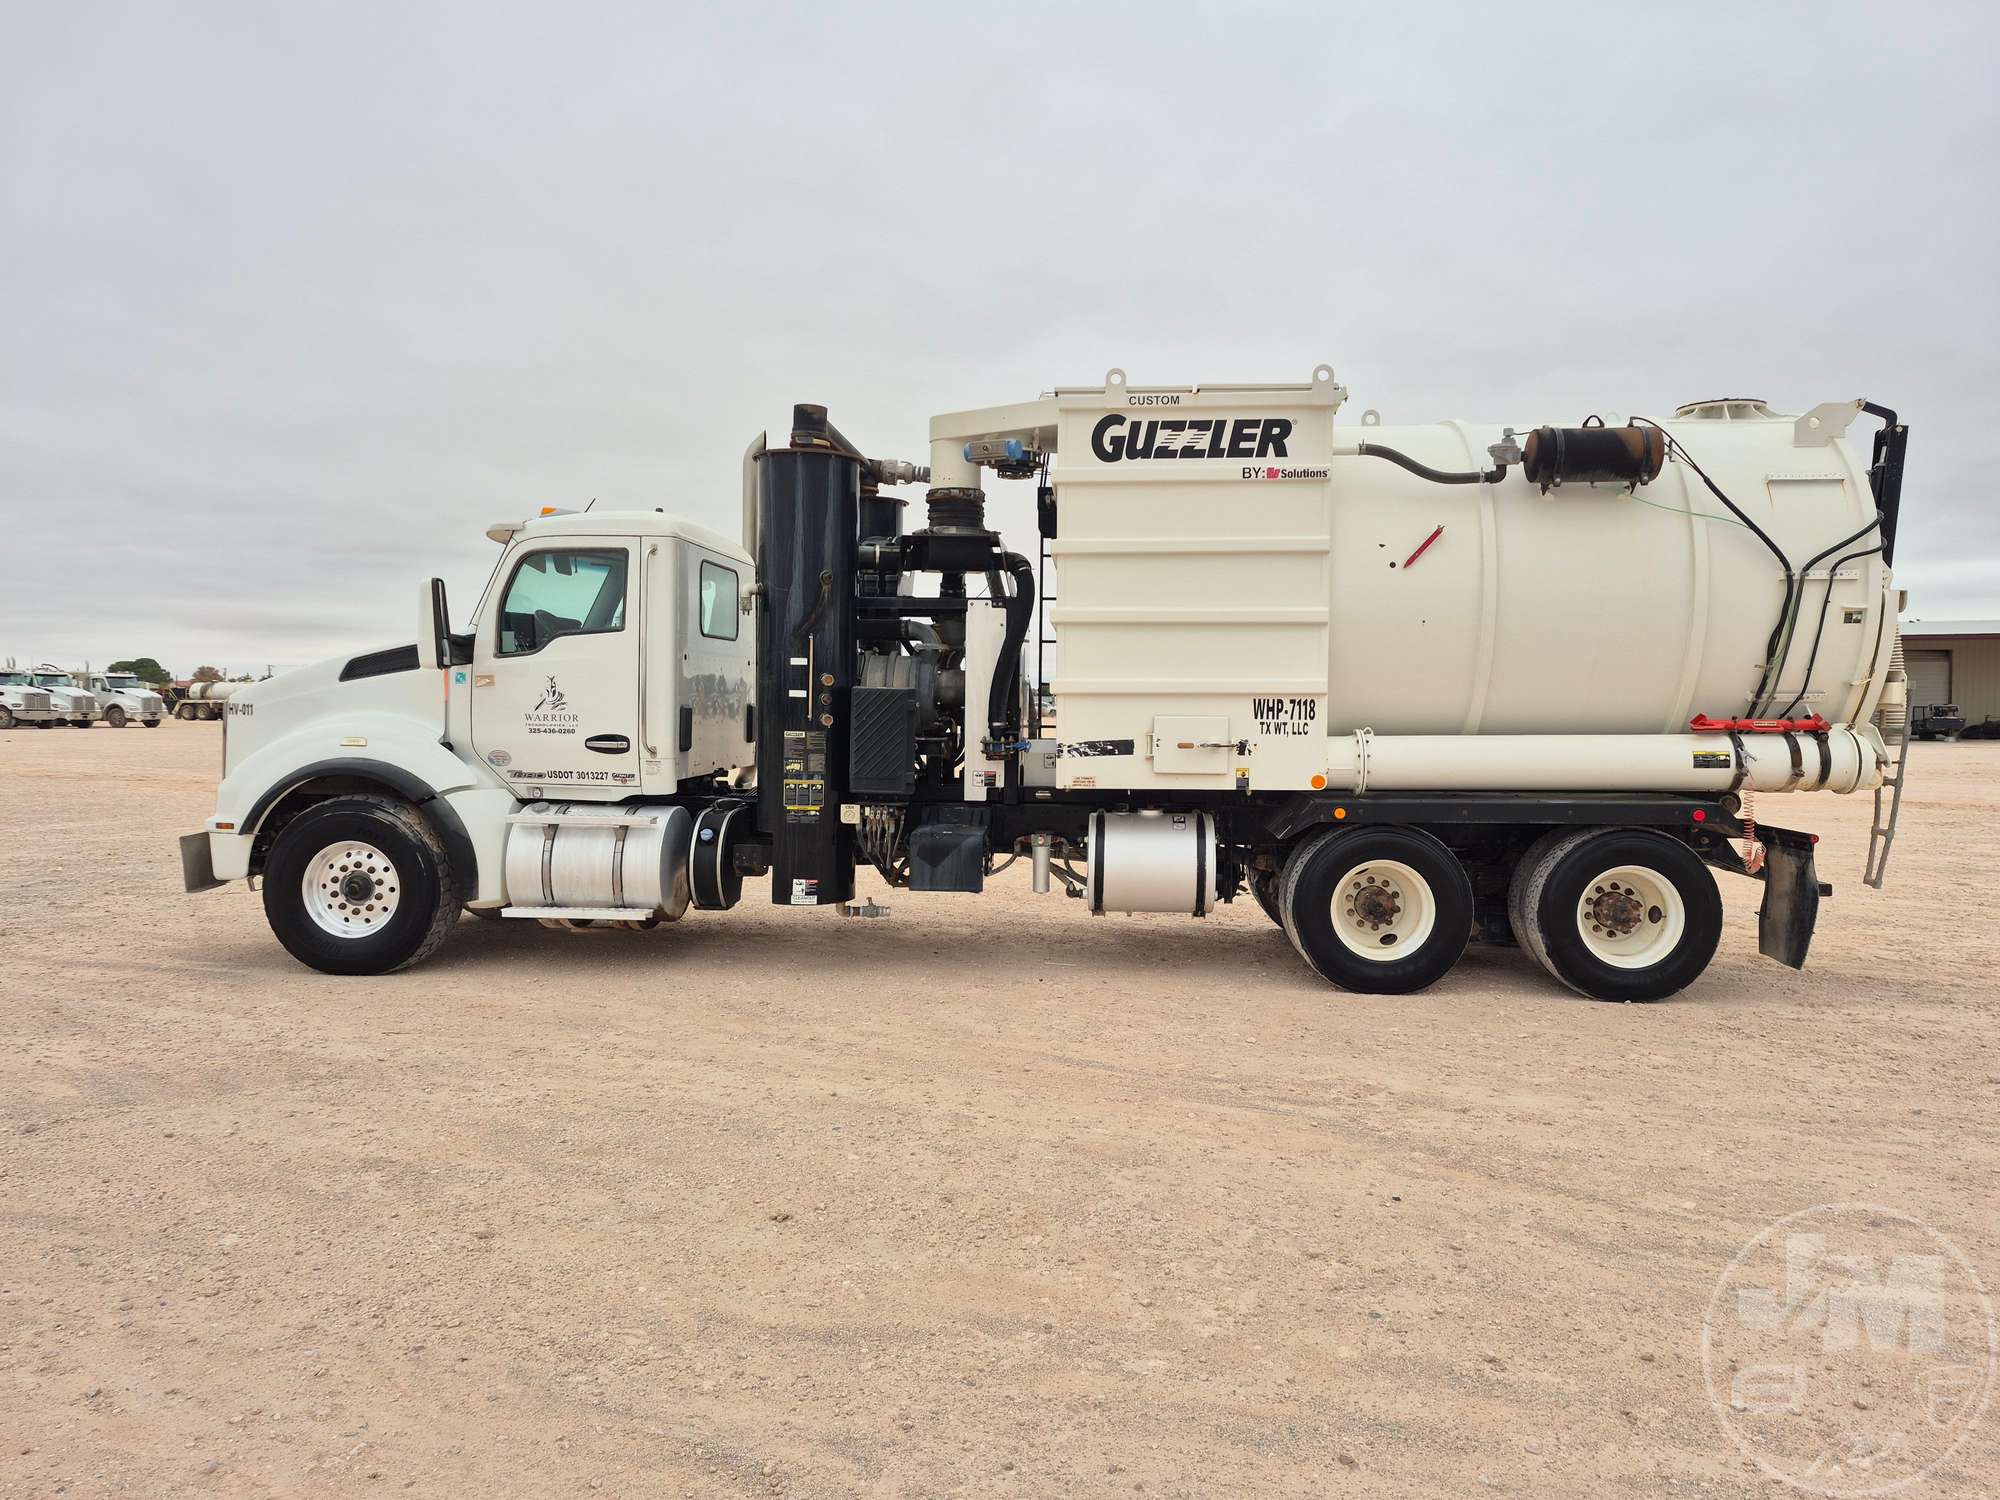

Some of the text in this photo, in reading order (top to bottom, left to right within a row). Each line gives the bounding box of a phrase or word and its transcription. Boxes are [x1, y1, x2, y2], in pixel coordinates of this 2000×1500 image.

[1128, 395, 1180, 406] CUSTOM
[1091, 413, 1293, 463] GUZZLER
[1242, 467, 1266, 479] BY:
[1281, 468, 1328, 479] Solutions
[524, 713, 579, 722] WARRIOR
[1260, 721, 1309, 738] TX WT, LLC
[546, 770, 573, 779] USDOT
[576, 771, 609, 780] 3013227
